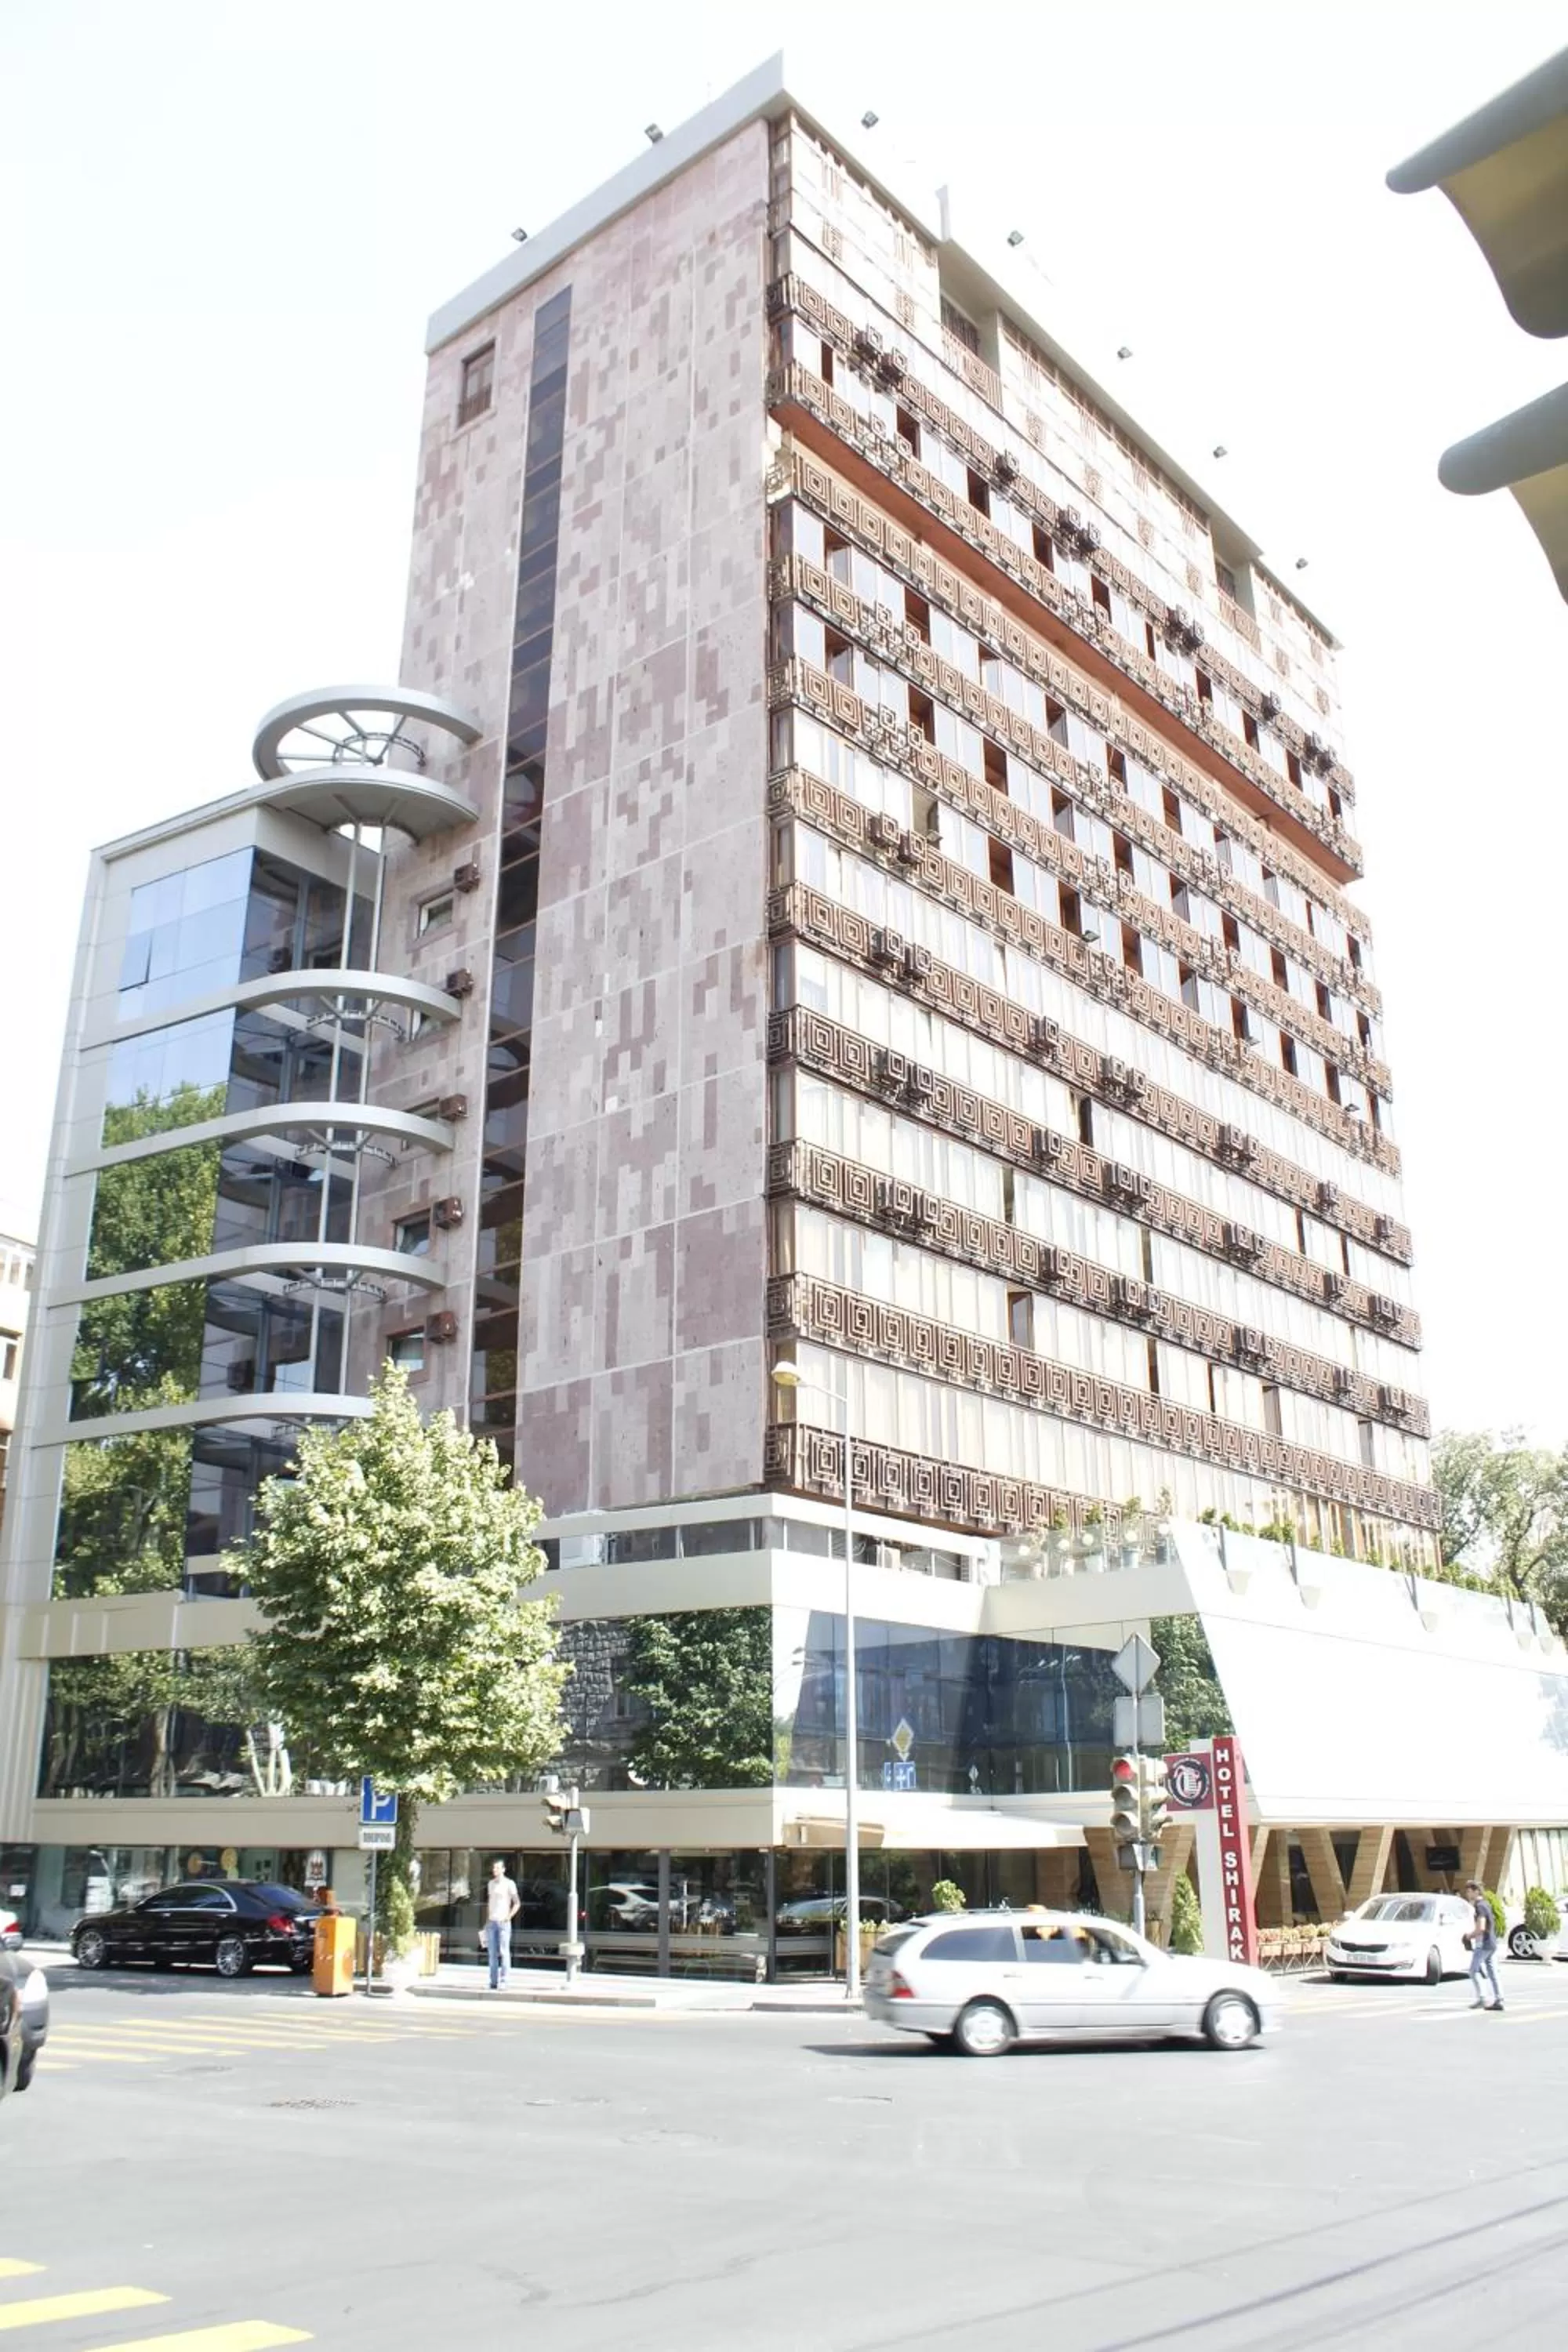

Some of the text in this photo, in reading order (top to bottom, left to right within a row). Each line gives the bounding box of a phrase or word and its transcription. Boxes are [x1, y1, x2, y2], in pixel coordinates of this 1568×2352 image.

[371, 1789, 391, 1820] P
[1216, 1748, 1245, 1960] HOTEL SHIRAK
